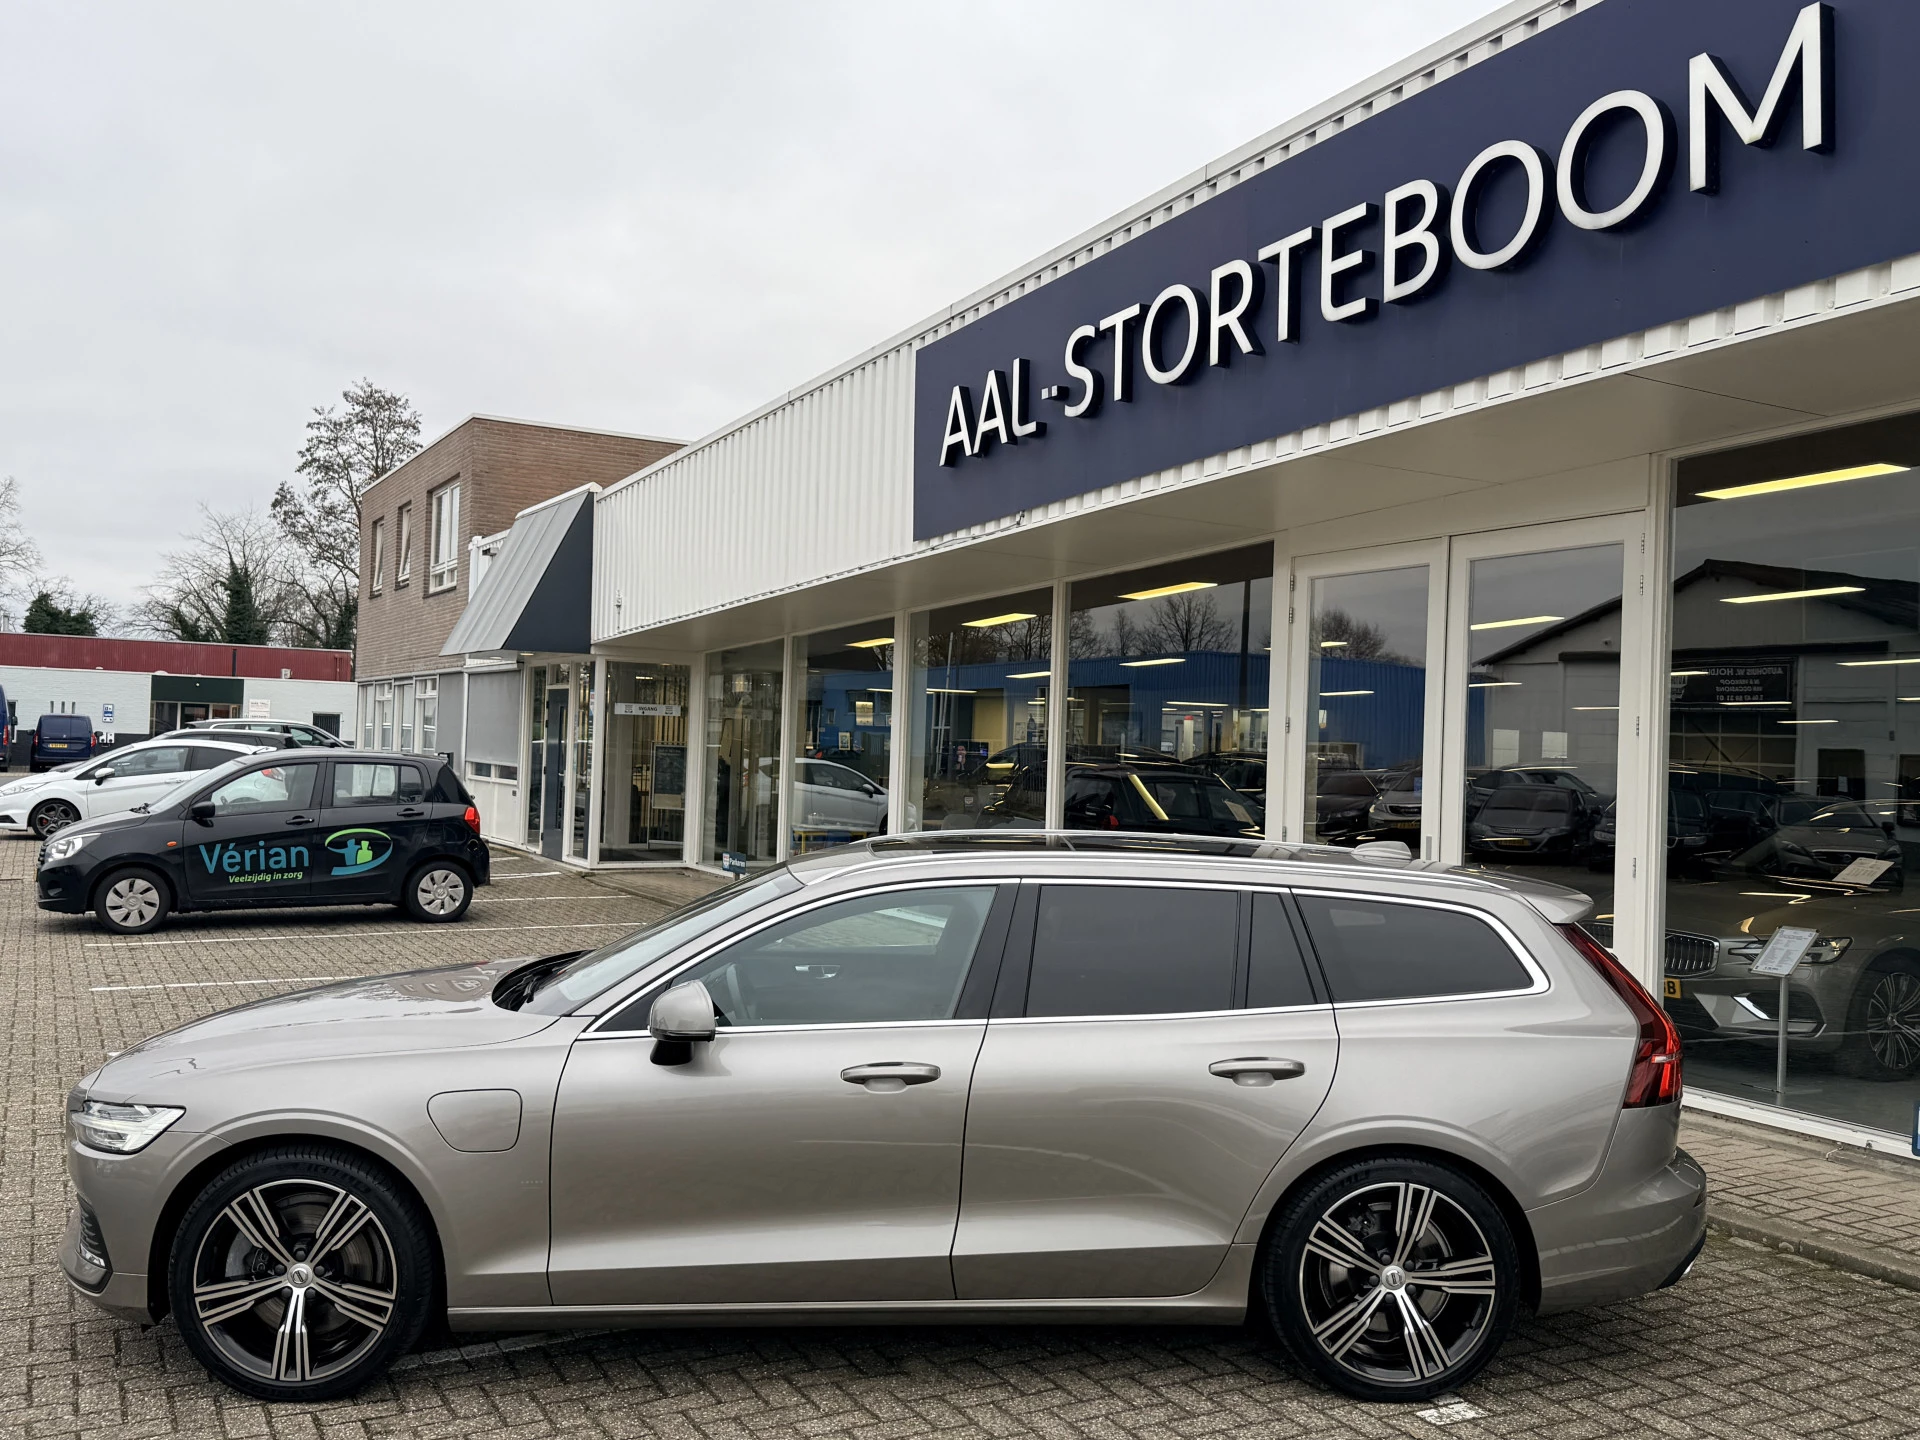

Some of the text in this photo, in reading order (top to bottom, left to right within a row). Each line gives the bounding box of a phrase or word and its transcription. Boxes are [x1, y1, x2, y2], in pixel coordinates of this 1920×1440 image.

[199, 840, 310, 874] Vérian
[228, 871, 303, 884] Veelzijdig in zorg
